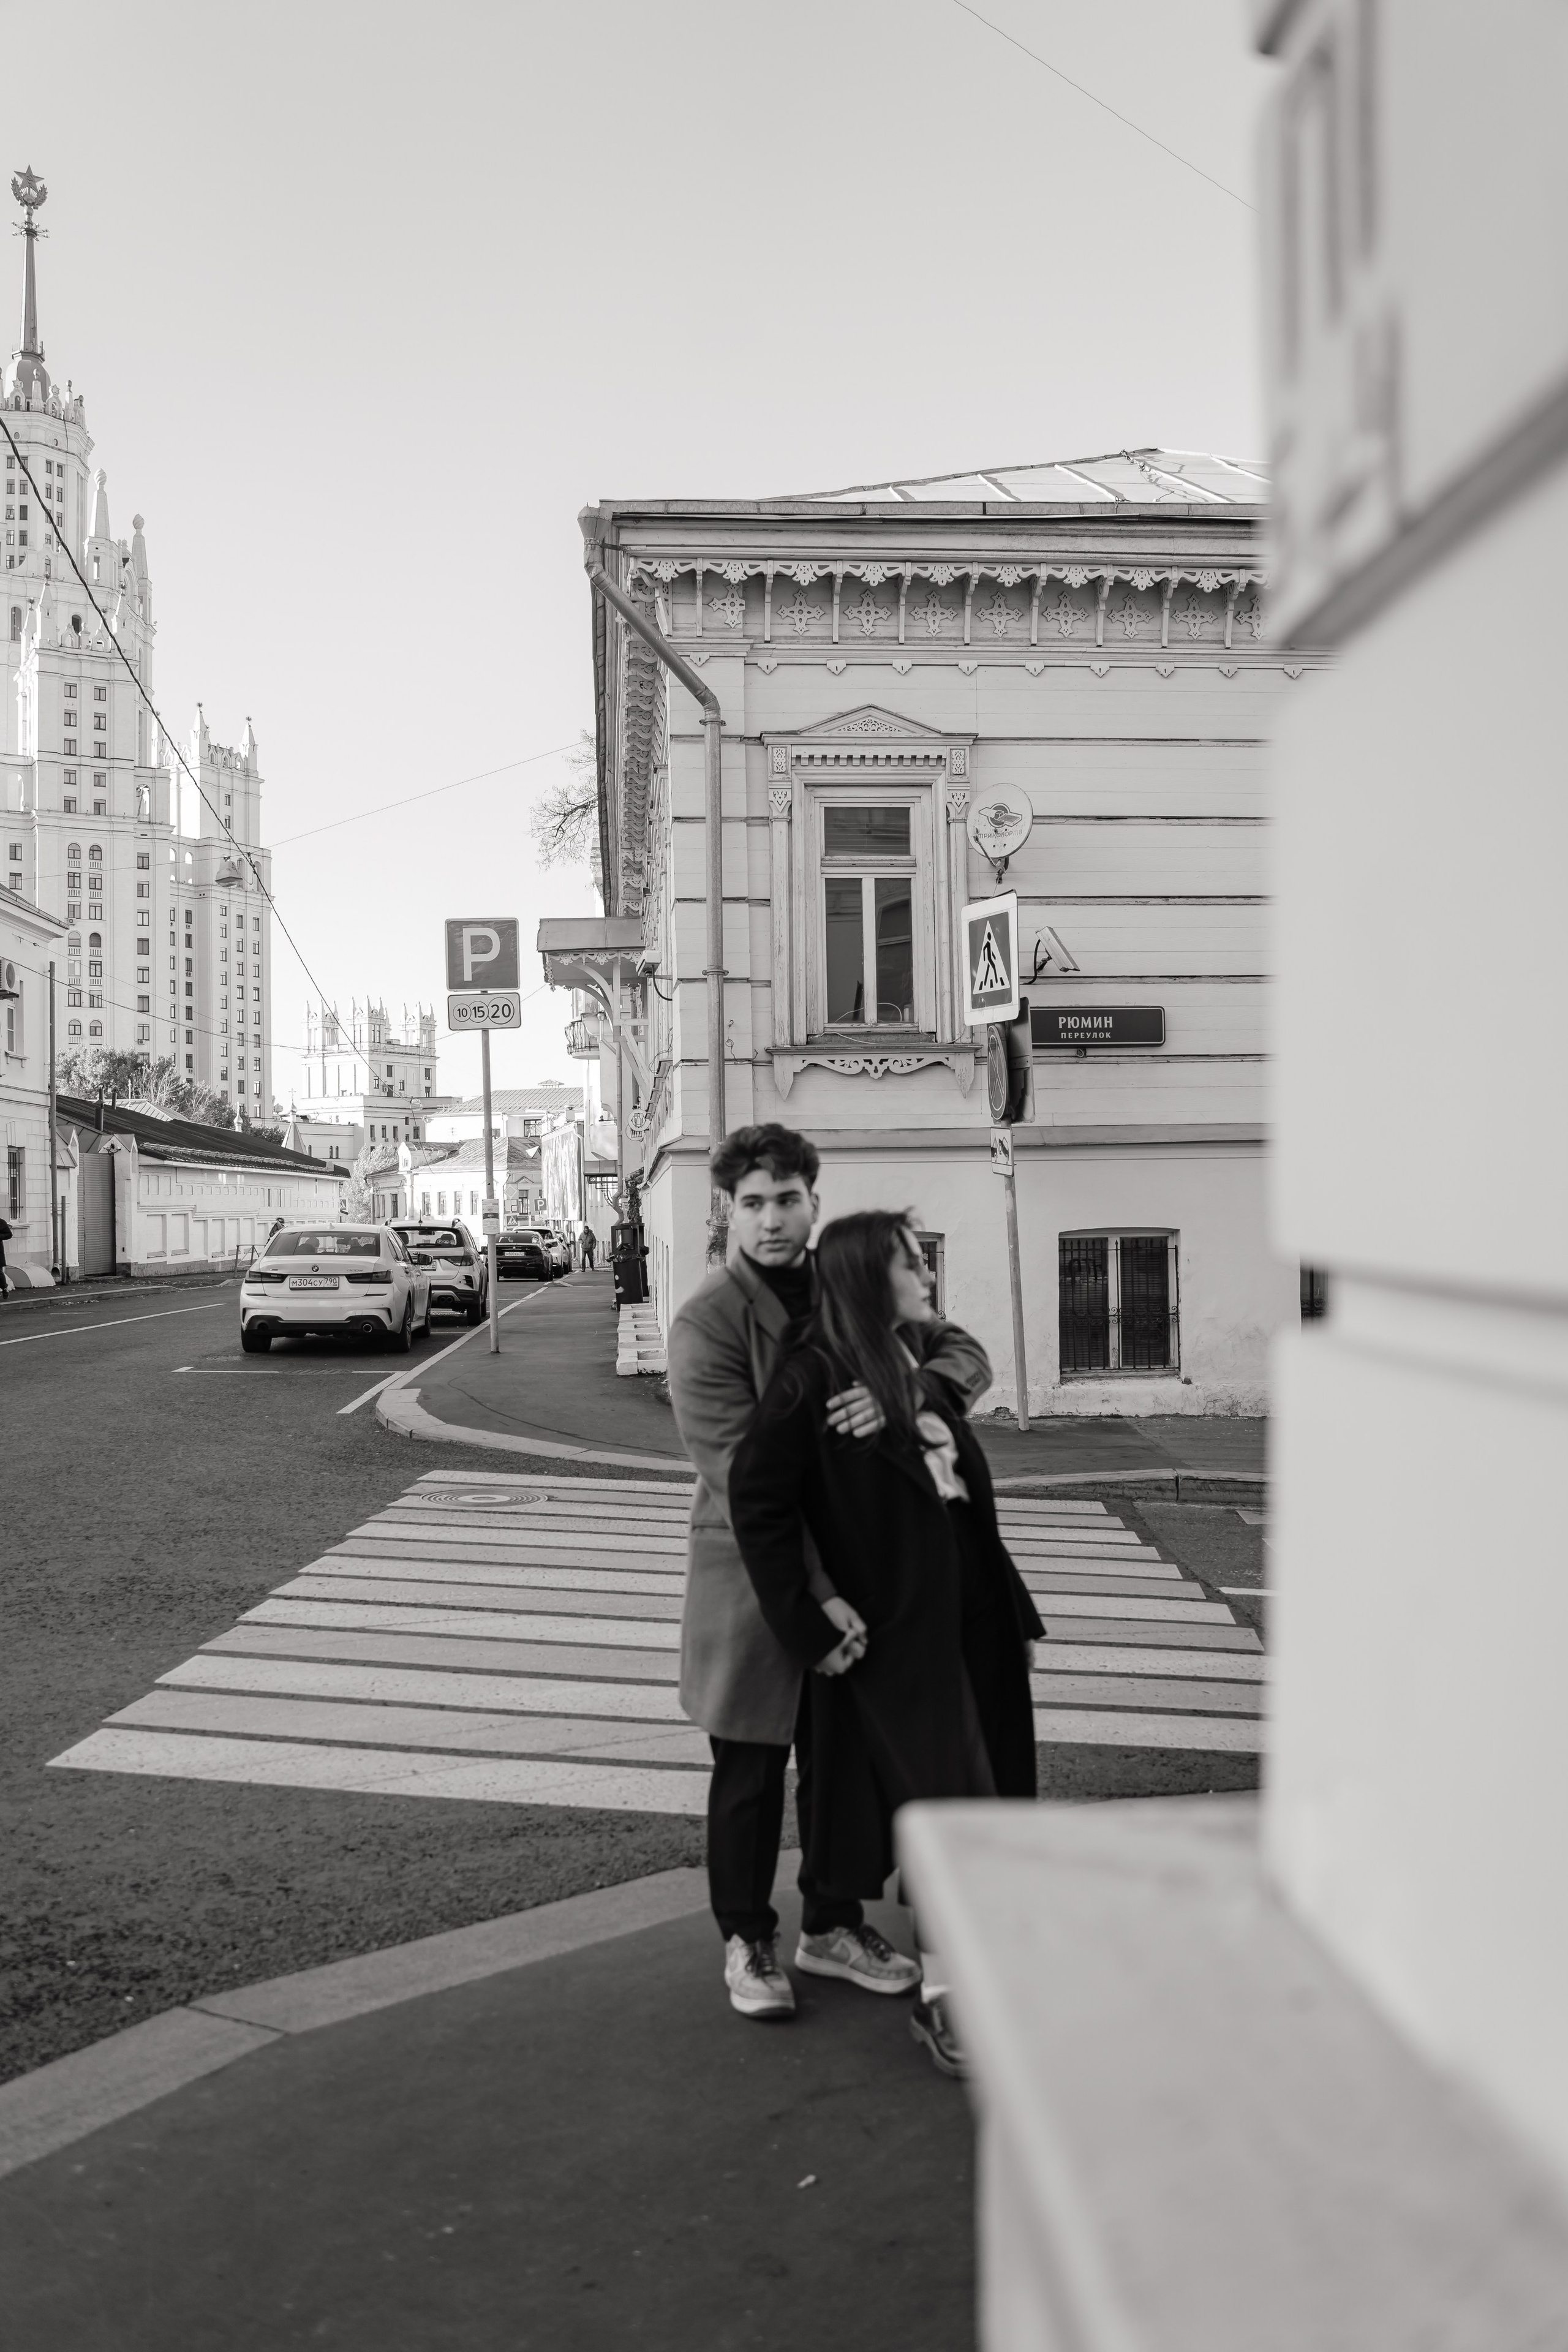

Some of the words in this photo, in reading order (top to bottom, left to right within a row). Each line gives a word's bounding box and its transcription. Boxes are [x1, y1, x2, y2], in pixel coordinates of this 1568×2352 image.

[462, 927, 500, 981] P
[457, 1008, 468, 1018] 10
[472, 1006, 485, 1018] 15
[491, 1003, 511, 1019] 20
[1058, 1016, 1113, 1028] РЮМИН
[537, 1199, 545, 1210] P
